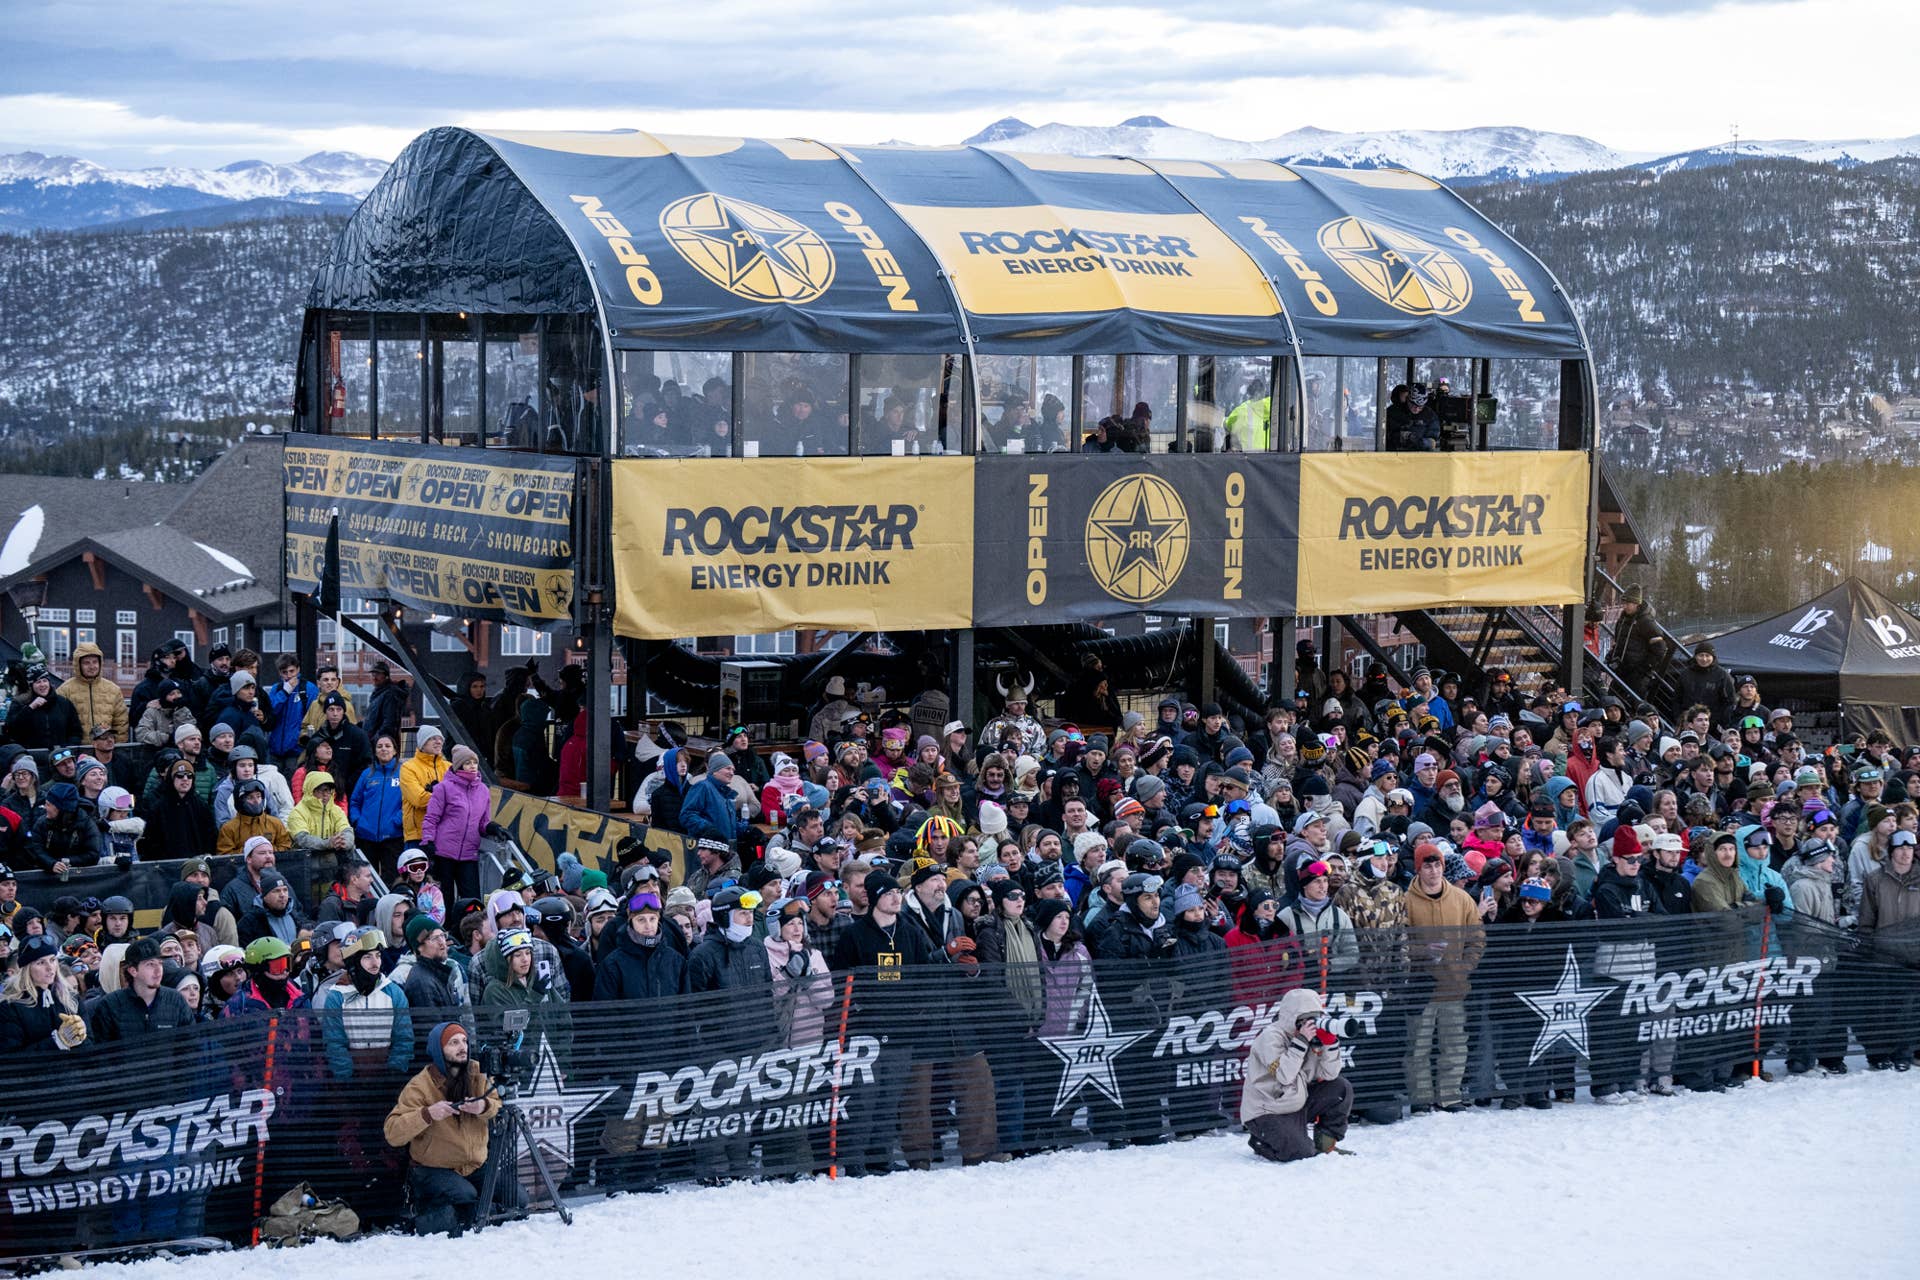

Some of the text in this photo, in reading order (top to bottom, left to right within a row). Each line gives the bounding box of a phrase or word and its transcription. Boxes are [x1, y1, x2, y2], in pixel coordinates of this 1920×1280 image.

[569, 194, 663, 306] OPEN
[823, 201, 919, 311] OPEN
[959, 228, 1197, 258] ROCKSTAR
[1002, 254, 1192, 277] ENERGY DRINK
[1238, 215, 1339, 317] OPEN
[1443, 226, 1546, 323] OPEN
[345, 470, 402, 499] OPEN
[425, 464, 492, 484] ROCKSTAR ENERGY
[513, 473, 550, 490] ROCKSTAR
[420, 478, 486, 509] OPEN
[505, 488, 571, 520] OPEN
[348, 512, 427, 538] SNOWBOARDING
[433, 523, 469, 543] BRECK
[662, 504, 919, 556] ROCKSTAR
[1338, 493, 1545, 541] ROCKSTAR
[1026, 473, 1049, 606] OPEN
[1223, 471, 1246, 600] OPEN
[313, 554, 366, 585] OEN
[378, 550, 439, 572] ROCKSTAR ENERGY
[461, 562, 535, 587] ROCKSTAR ENERGY
[1360, 544, 1524, 571] ENERGY DRINK
[382, 563, 440, 598] OPEN
[690, 561, 891, 590] ENERGY DRINK
[463, 578, 542, 613] OPEN
[1768, 633, 1811, 650] BRECK
[916, 708, 944, 721] UNION
[1620, 956, 1822, 1017] ROCKSTAR
[1152, 991, 1384, 1058] ROCKAR
[1637, 1004, 1794, 1042] ENERGY DRINK
[623, 1035, 881, 1120] ROCKSTAR
[1176, 1057, 1250, 1088] ENER
[0, 1088, 277, 1179] ROCKSTAR
[642, 1095, 851, 1147] ENERGY DRINK
[7, 1156, 244, 1215] ENERGY DRINK
